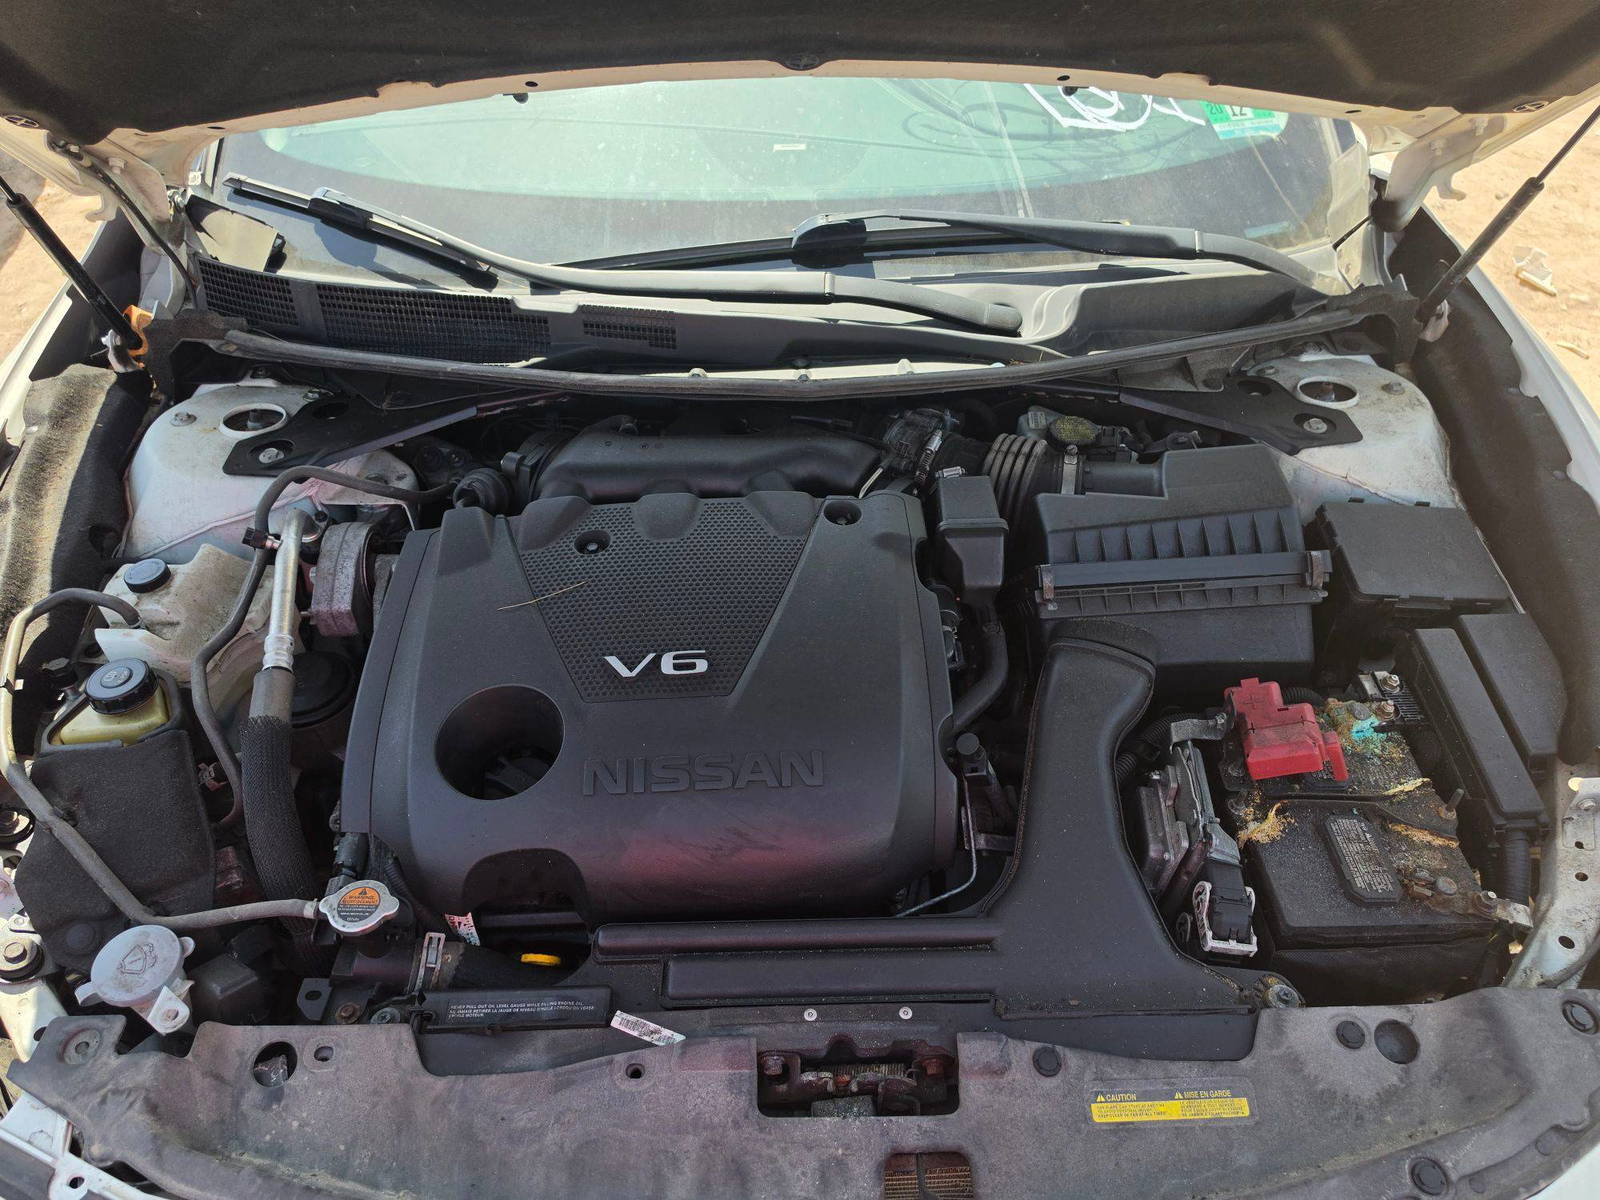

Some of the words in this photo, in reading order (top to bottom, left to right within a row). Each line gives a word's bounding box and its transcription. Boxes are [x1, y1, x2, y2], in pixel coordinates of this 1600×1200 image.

[604, 650, 708, 677] V6
[583, 751, 824, 795] NISSAN
[1106, 1093, 1137, 1102] CAUTION
[1184, 1091, 1199, 1099] MISE
[1200, 1090, 1209, 1098] EN
[1210, 1089, 1232, 1098] GARDE
